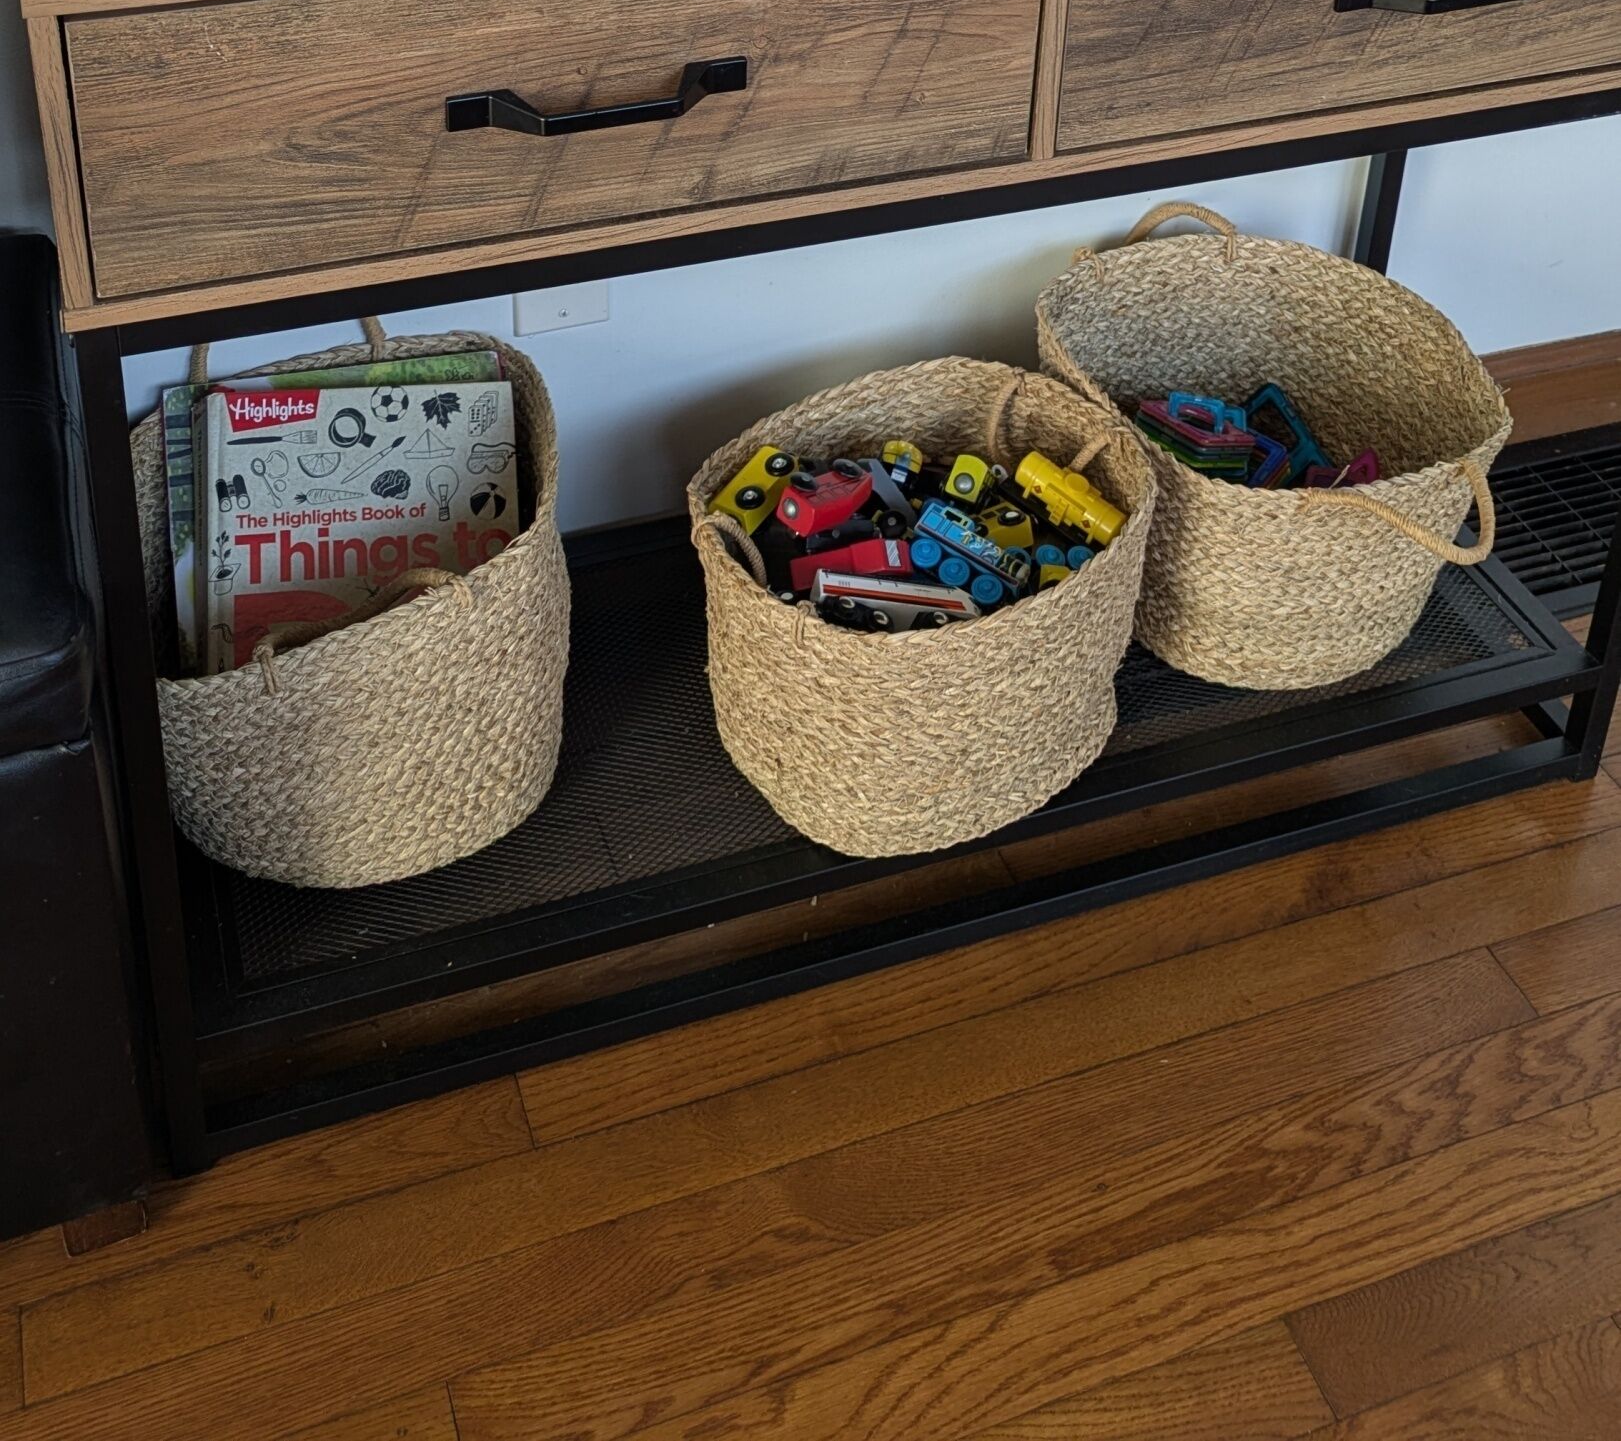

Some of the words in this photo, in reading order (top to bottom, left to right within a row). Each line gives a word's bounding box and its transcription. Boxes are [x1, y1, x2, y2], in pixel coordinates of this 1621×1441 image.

[229, 397, 315, 422] Highlights
[235, 514, 268, 529] The
[273, 507, 357, 528] Highlights
[362, 504, 405, 521] Book
[409, 503, 427, 518] of
[234, 527, 441, 586] Things
[453, 521, 512, 570] to
